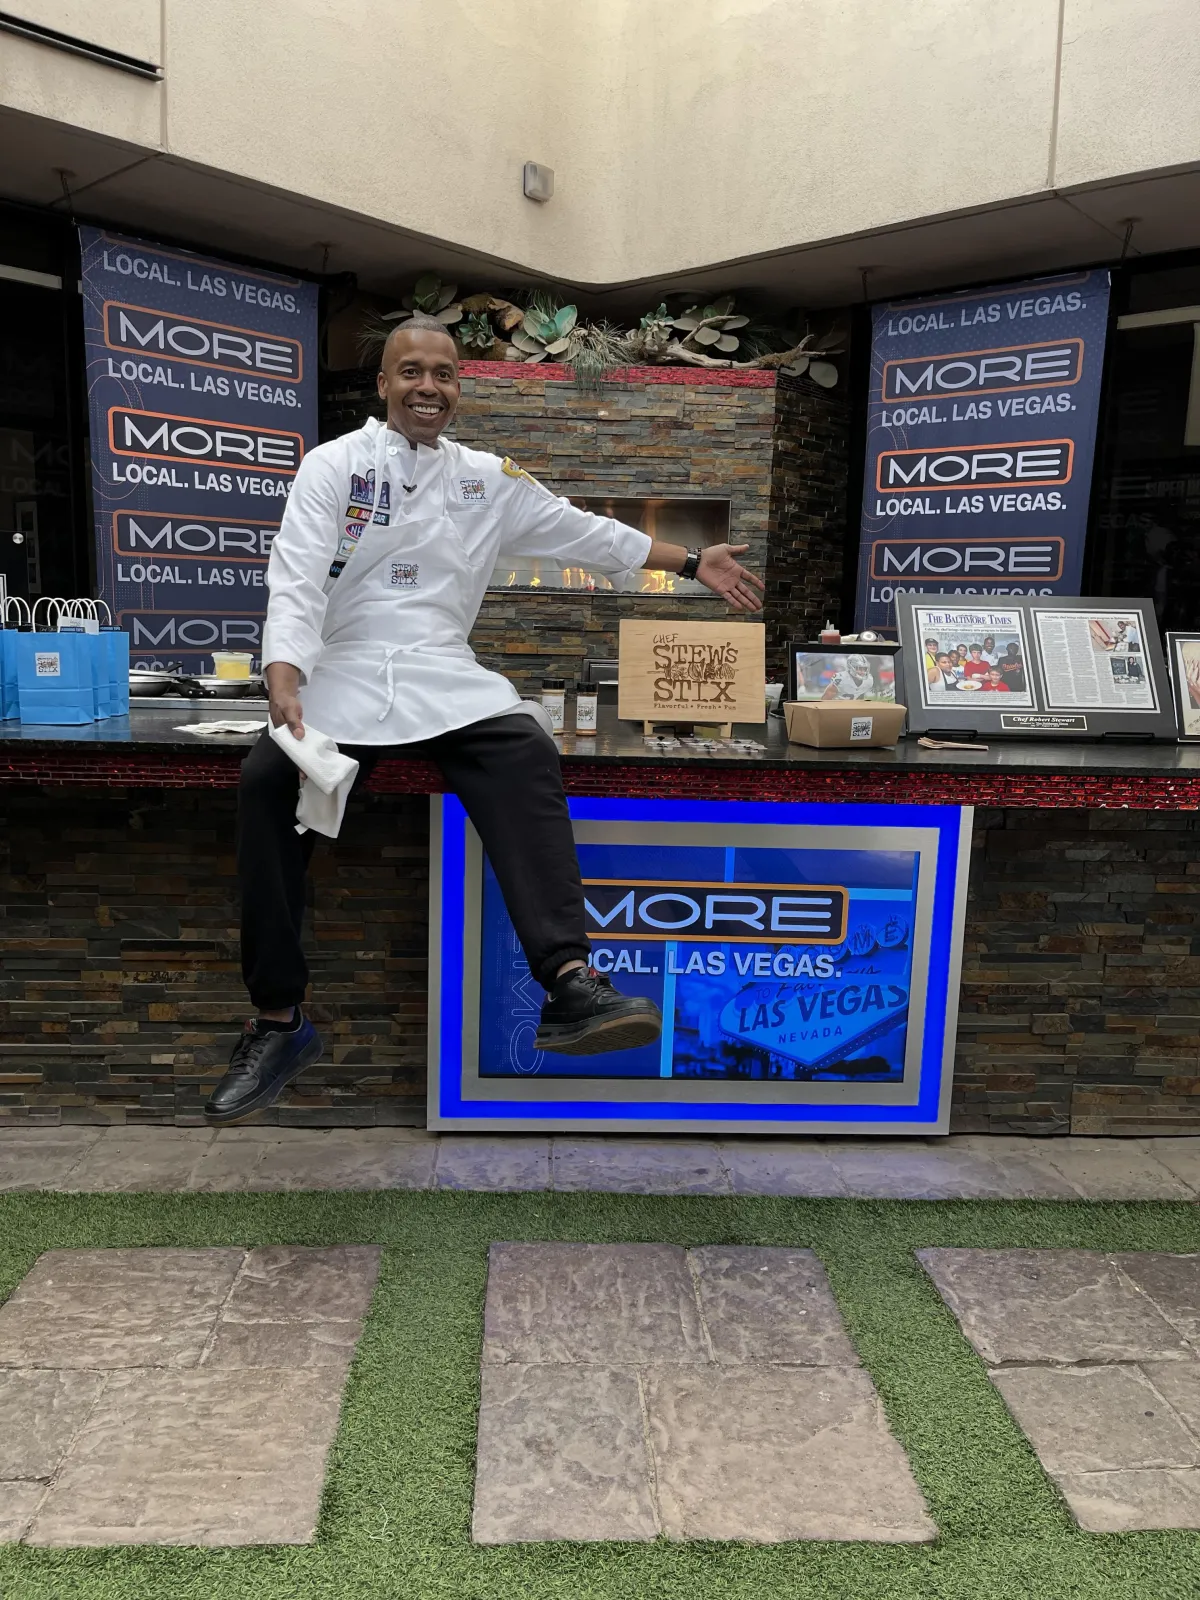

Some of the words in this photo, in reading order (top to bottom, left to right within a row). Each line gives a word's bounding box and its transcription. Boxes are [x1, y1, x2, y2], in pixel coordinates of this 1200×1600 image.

[103, 250, 181, 287] LOCAL.
[187, 270, 227, 297] LAS
[232, 281, 301, 314] VEGAS.
[888, 312, 954, 336] LOCAL.
[961, 304, 1001, 327] LAS
[1006, 292, 1087, 320] VEGAS.
[119, 311, 293, 373] MORE
[107, 358, 185, 389] LOCAL.
[190, 372, 230, 396] LAS
[234, 380, 302, 408] VEGAS.
[895, 348, 1072, 394] MORE
[881, 406, 947, 427] LOCAL.
[952, 401, 992, 421] LAS
[997, 393, 1076, 417] VEGAS.
[124, 416, 295, 466] MORE
[112, 462, 189, 488] LOCAL.
[194, 471, 233, 493] LAS
[888, 449, 1062, 484] MORE
[876, 498, 941, 516] LOCAL.
[945, 495, 984, 514] LAS
[989, 491, 1067, 512] VEGAS.
[117, 563, 192, 585] LOCAL.
[198, 567, 235, 586] LAS
[883, 546, 1053, 573] MORE
[133, 616, 266, 646] MOR
[926, 613, 943, 624] THE
[944, 613, 986, 625] BALTIMORE
[988, 614, 1012, 625] TIMES
[652, 633, 679, 644] CHEF
[653, 677, 737, 703] STIX
[584, 890, 833, 933] MORE
[588, 948, 659, 974] CAL.
[667, 950, 726, 976] LAS
[733, 952, 842, 978] VEGAS.
[738, 1000, 786, 1033] LAS
[796, 984, 909, 1023] VEGAS
[778, 1026, 843, 1044] NEVADA
